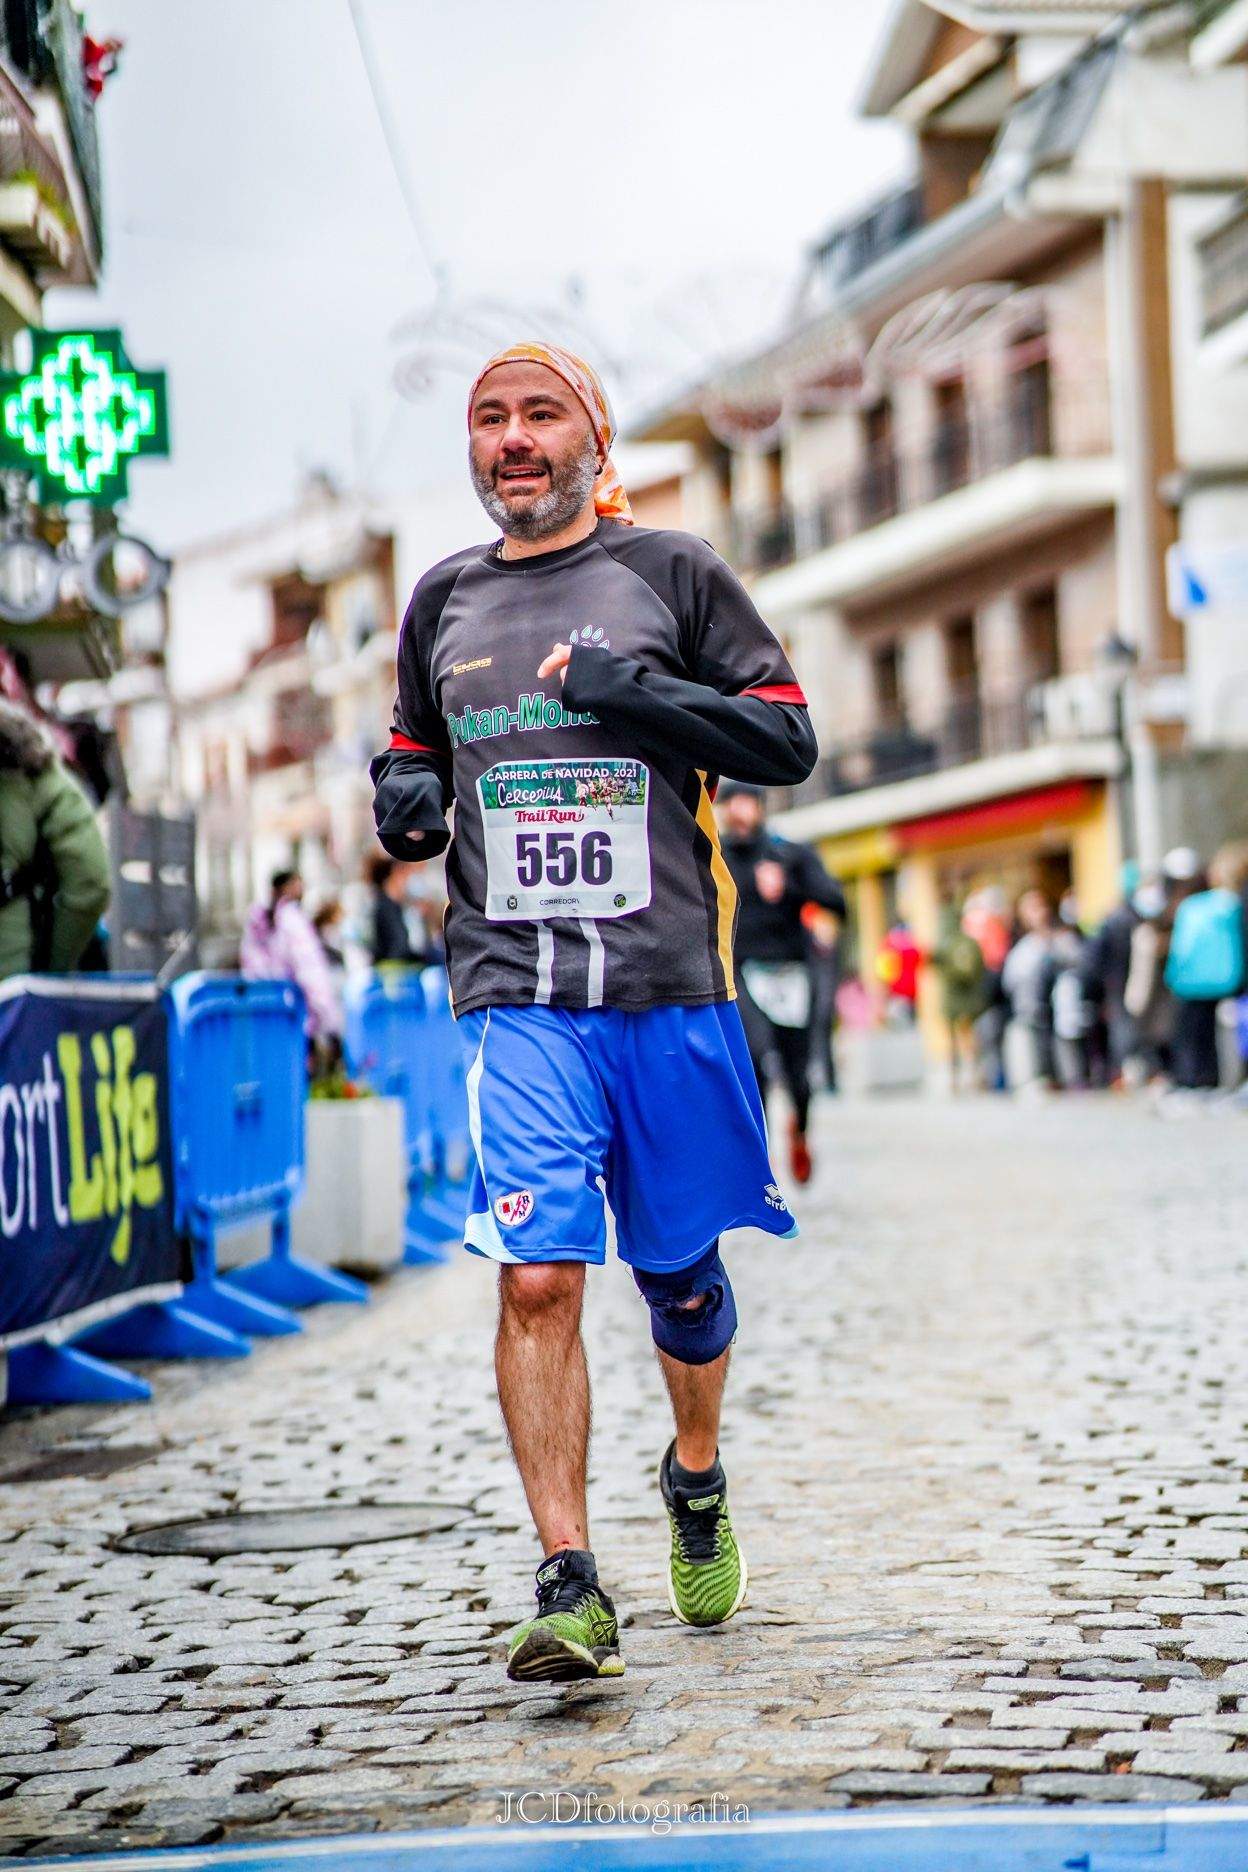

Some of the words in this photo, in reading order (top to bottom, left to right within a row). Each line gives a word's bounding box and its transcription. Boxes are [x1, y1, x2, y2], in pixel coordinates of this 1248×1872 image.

[486, 770, 539, 782] CARRERA
[555, 767, 610, 779] NAVIDAD
[613, 768, 637, 778] 2021
[515, 830, 614, 888] 556
